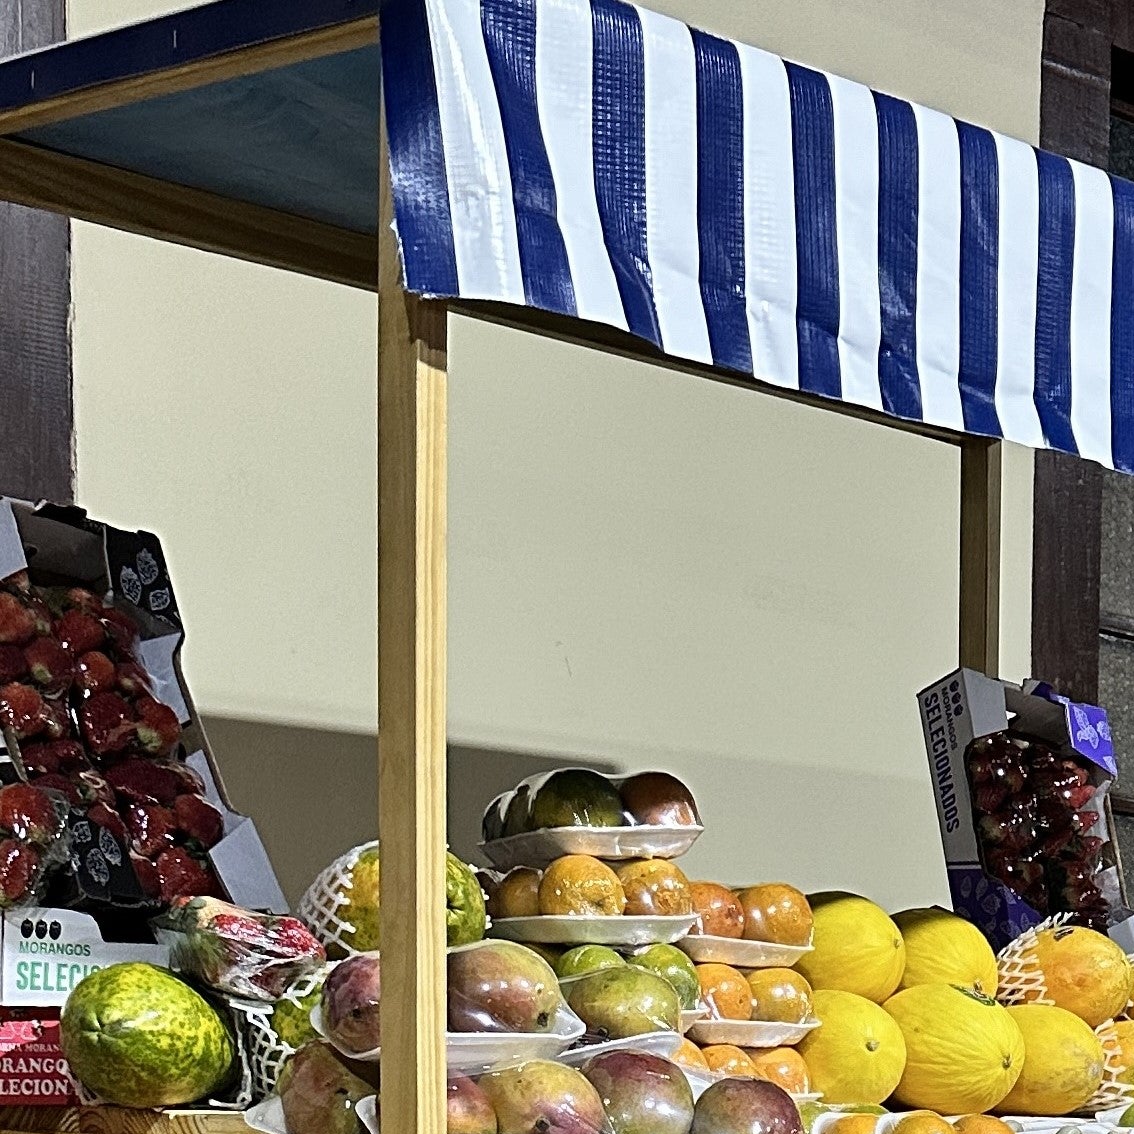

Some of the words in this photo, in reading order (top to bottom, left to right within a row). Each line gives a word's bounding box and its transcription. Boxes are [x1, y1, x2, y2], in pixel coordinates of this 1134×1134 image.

[924, 692, 960, 834] SELECIONADOS
[19, 941, 91, 957] MORANGOS
[0, 1058, 70, 1076] RANGO
